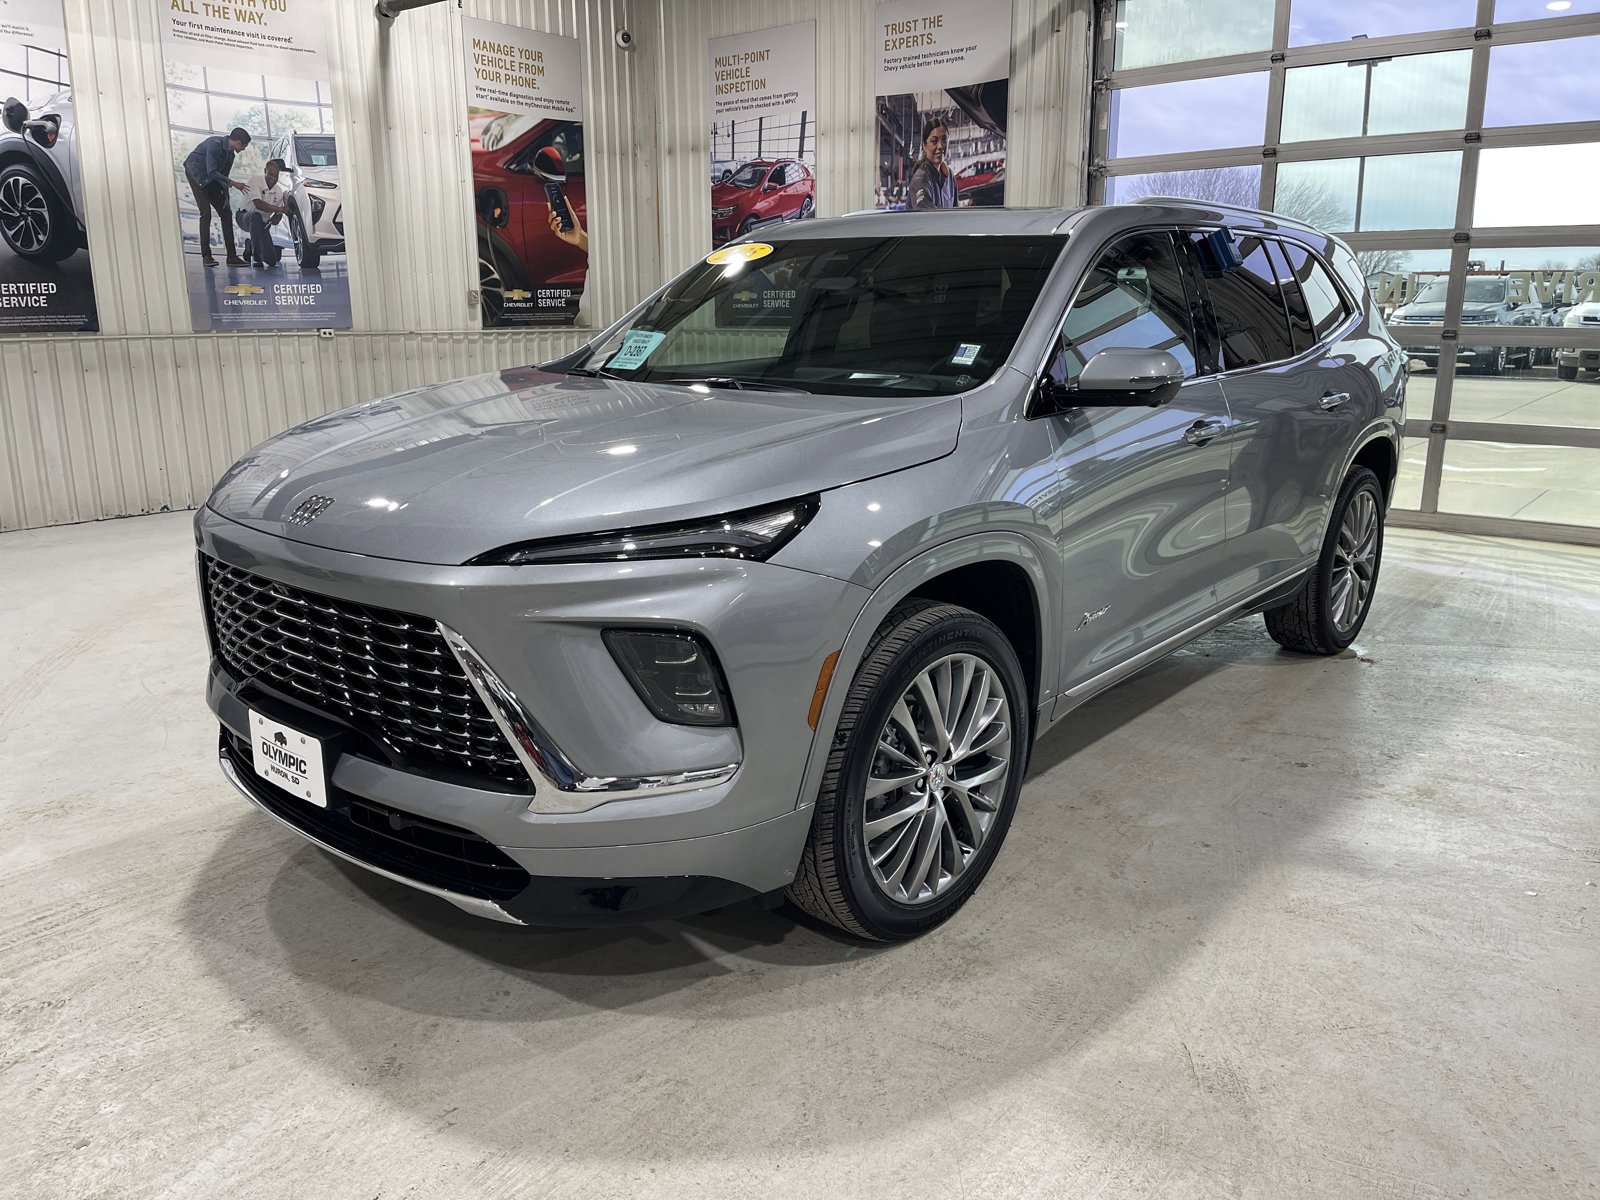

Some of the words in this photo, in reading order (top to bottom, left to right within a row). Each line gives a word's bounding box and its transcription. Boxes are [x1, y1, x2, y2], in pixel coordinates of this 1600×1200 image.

[171, 0, 199, 14] ALL
[202, 3, 230, 20] THE
[234, 8, 267, 26] WAY.
[171, 18, 187, 27] Your
[188, 21, 203, 30] first
[204, 25, 245, 37] maintenance
[246, 31, 260, 39] visit
[884, 19, 919, 36] TRUST
[922, 15, 943, 30] THE
[473, 38, 515, 57] MANAGE
[518, 47, 544, 63] YOUR
[884, 32, 937, 51] EXPERTS.
[714, 49, 771, 68] MULTI-POINT
[883, 57, 902, 65] Factory
[921, 50, 949, 59] technicians
[965, 45, 977, 53] your
[899, 62, 916, 70] vehicle
[946, 56, 966, 64] anyone.
[473, 53, 516, 72] VEHICLE
[518, 62, 545, 77] FROM
[714, 66, 751, 82] VEHICLE
[474, 67, 502, 83] YOUR
[504, 73, 540, 90] PHONE.
[715, 78, 766, 95] INSPECTION
[0, 283, 57, 295] ERTIFIED
[273, 284, 322, 294] CERTIFIED
[537, 289, 571, 298] CERTIFIED
[762, 290, 796, 299] CERTIFIED
[275, 295, 316, 305] SERVICE
[538, 299, 566, 307] SERVICE
[762, 299, 790, 308] SERVICE
[261, 741, 307, 775] OLYMPIC
[270, 764, 291, 783] HURON,
[291, 776, 300, 785] SD
